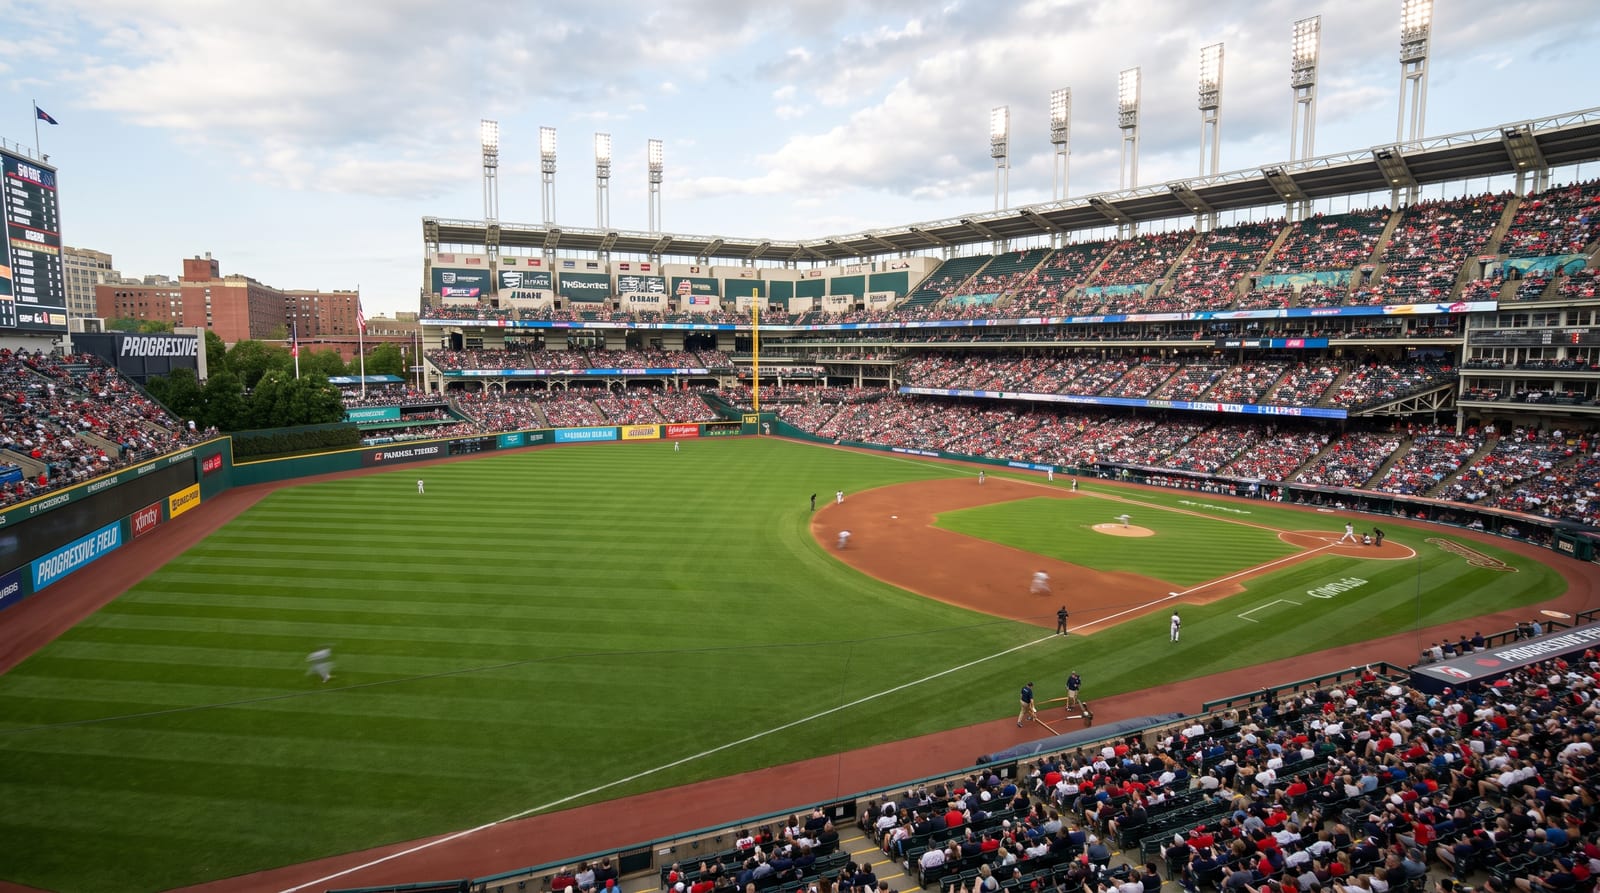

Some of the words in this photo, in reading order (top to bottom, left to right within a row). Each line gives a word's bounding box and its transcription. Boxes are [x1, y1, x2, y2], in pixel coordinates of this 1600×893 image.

[120, 336, 198, 357] PROGRESSIVE
[37, 537, 96, 585] PROGRESSIVE
[96, 527, 118, 554] FIELD
